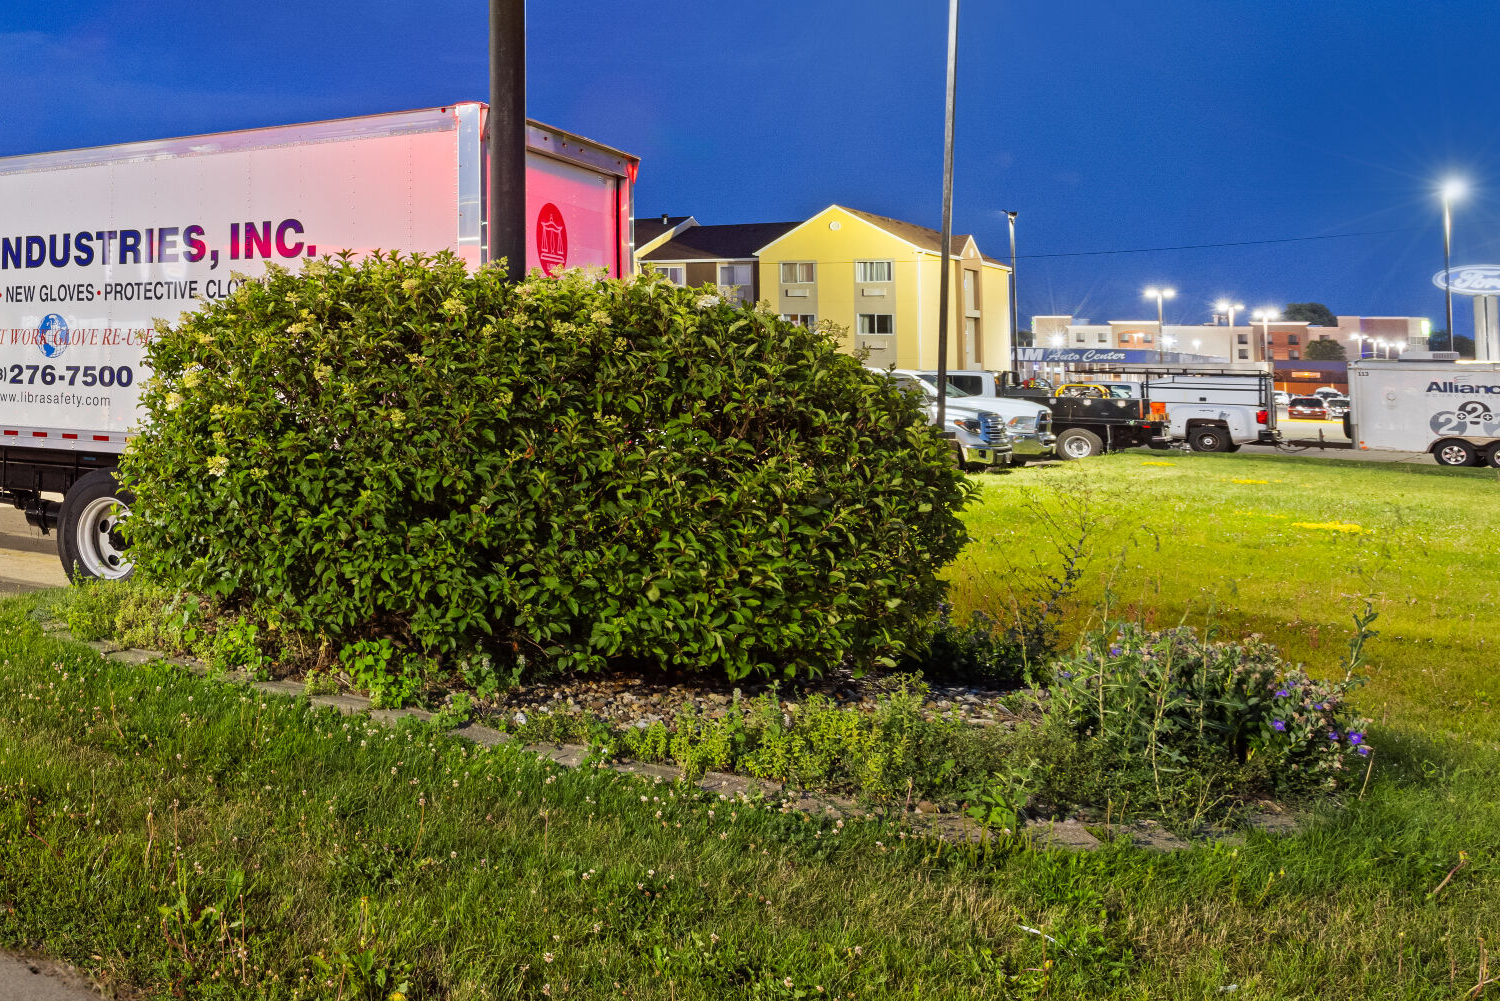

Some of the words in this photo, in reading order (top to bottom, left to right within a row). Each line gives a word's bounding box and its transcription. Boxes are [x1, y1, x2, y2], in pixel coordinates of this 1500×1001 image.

[230, 218, 317, 260] INC.
[6, 285, 35, 303] NEW
[39, 283, 94, 303] GLOVES
[104, 280, 198, 301] PROTECTIVE
[10, 328, 48, 345] WORK
[53, 328, 99, 346] GLOVE
[1047, 351, 1080, 361] Auto
[1082, 349, 1126, 361] Center
[9, 364, 134, 388] 276-7500
